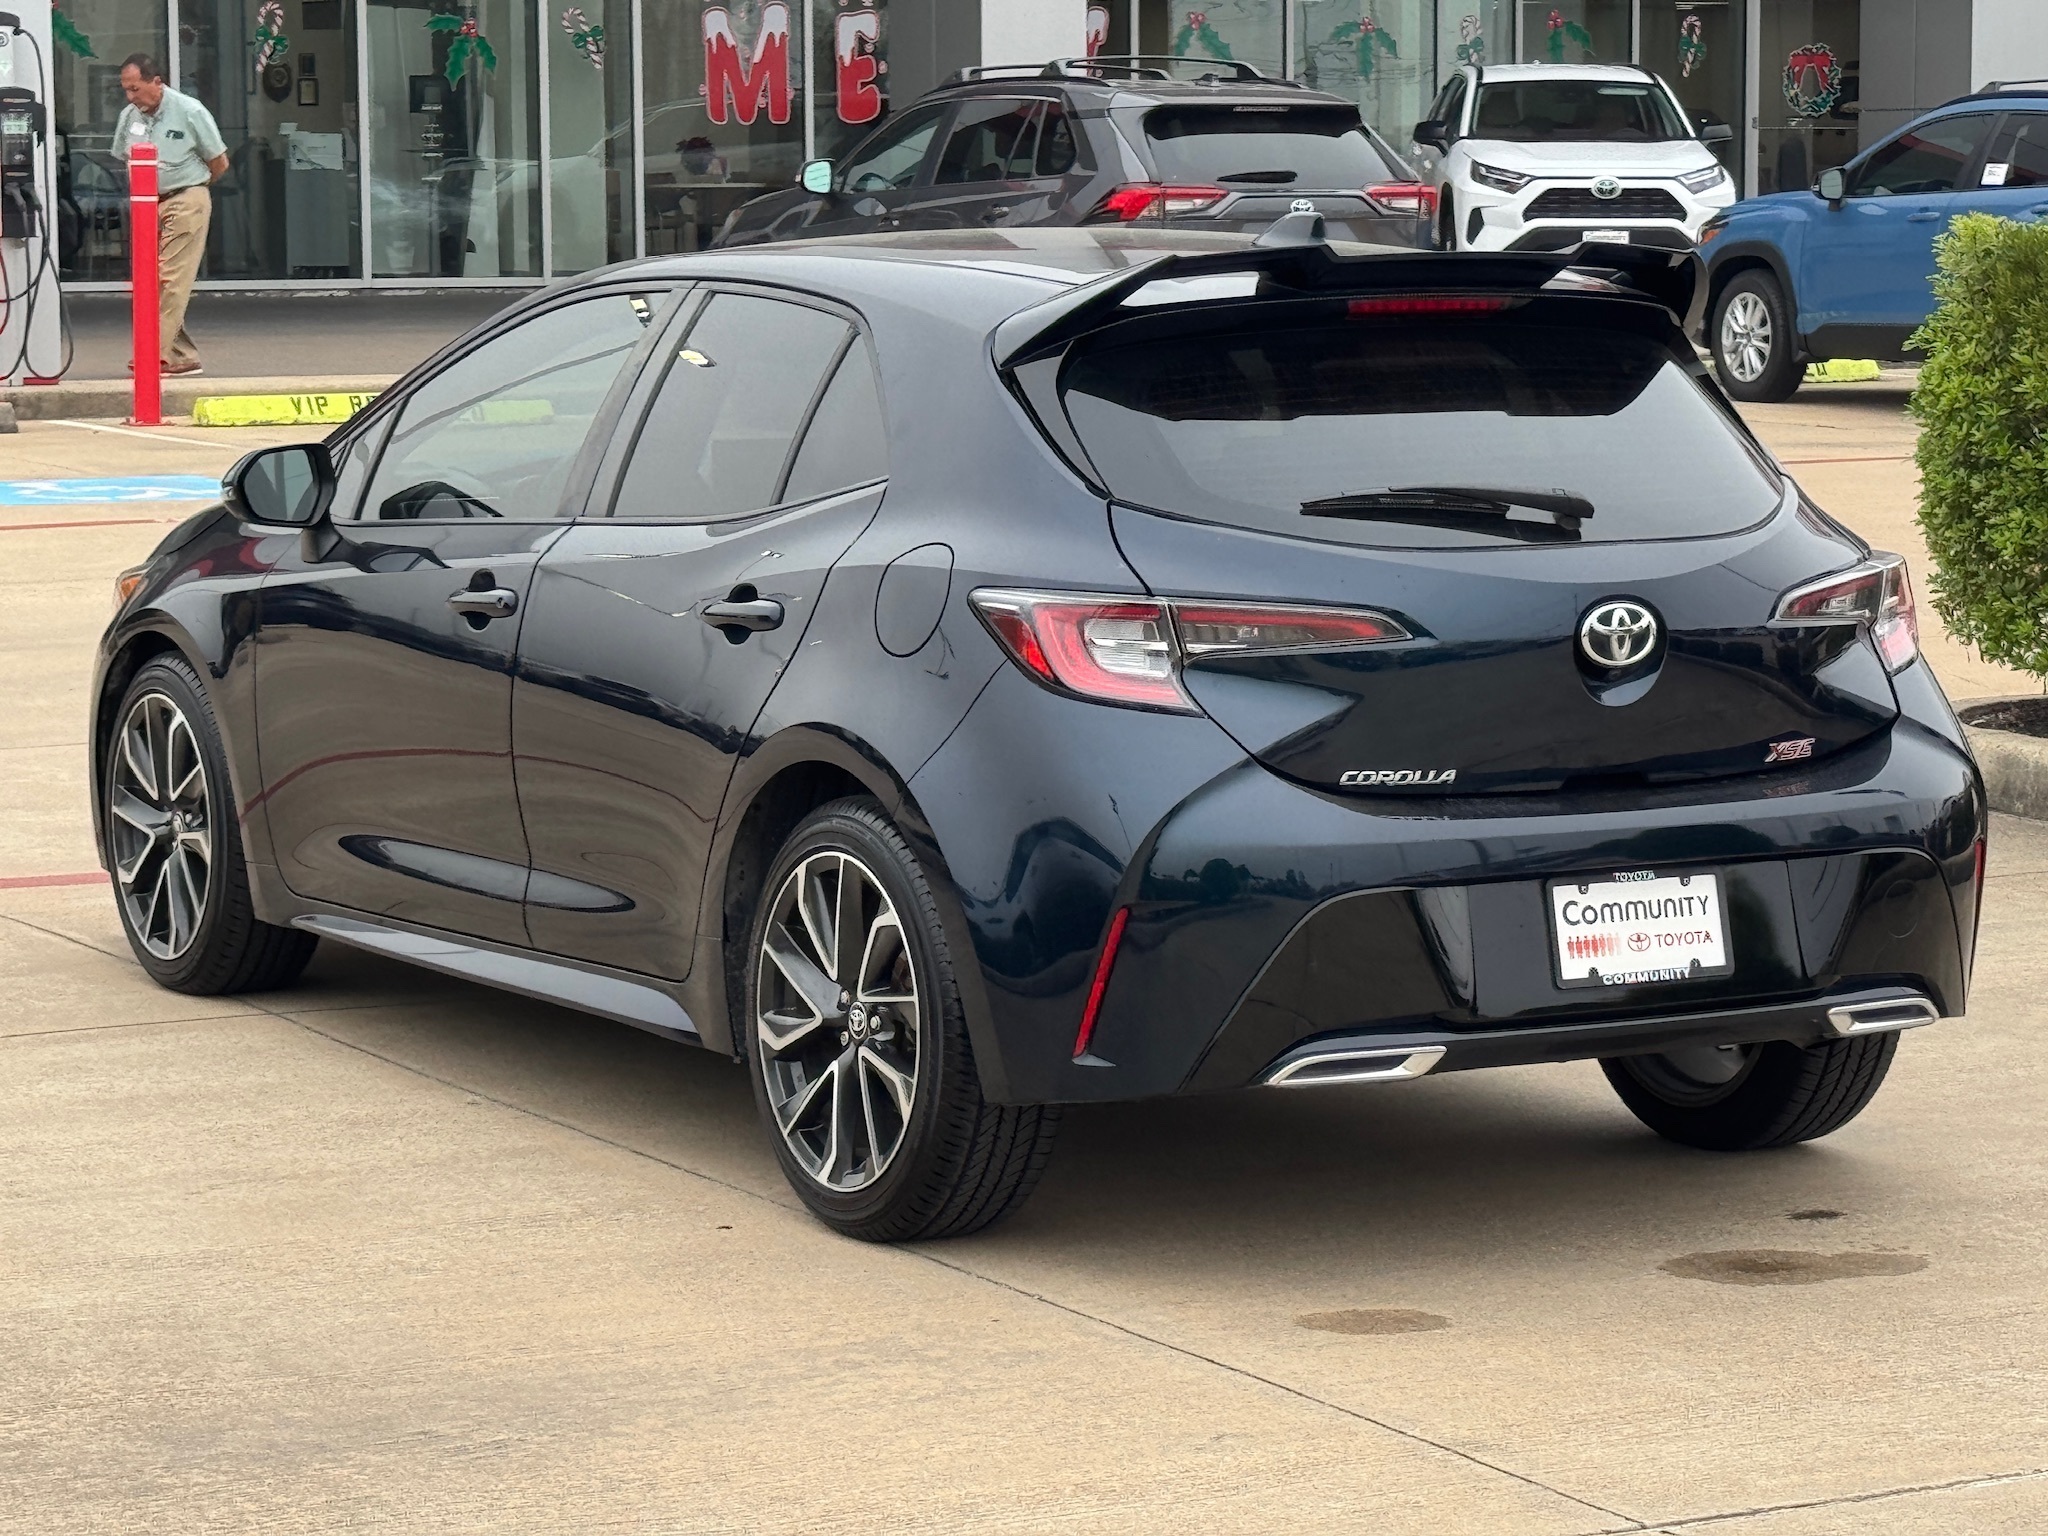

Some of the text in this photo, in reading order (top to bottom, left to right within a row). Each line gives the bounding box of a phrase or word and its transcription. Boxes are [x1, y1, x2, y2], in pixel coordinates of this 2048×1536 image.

[289, 396, 328, 415] VIP
[1764, 737, 1816, 763] XSE
[1339, 769, 1457, 786] COROLLA
[1612, 870, 1656, 883] TOYOTA
[1654, 930, 1714, 948] TOYOTA
[1602, 967, 1690, 986] COMMUNITY
